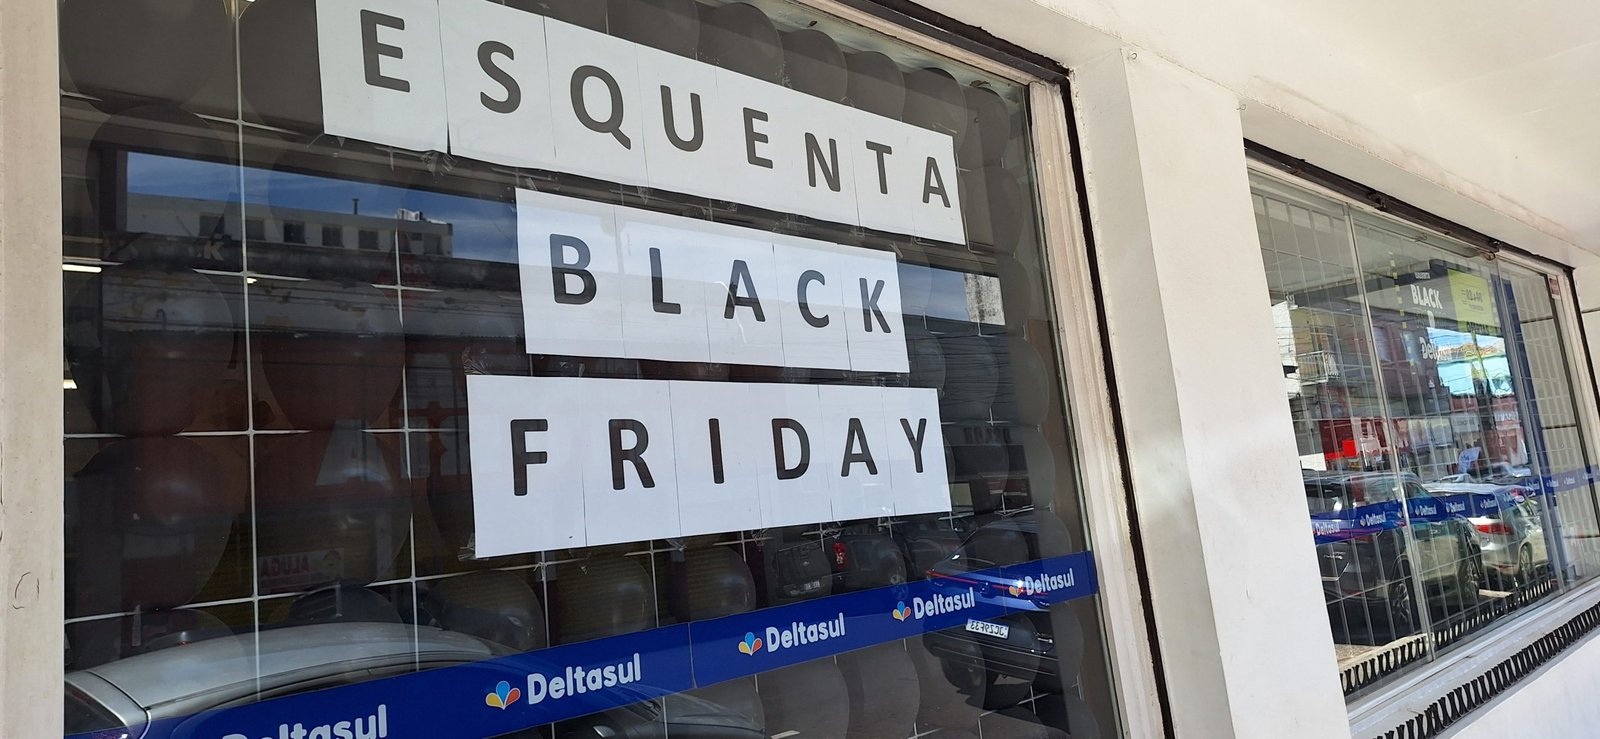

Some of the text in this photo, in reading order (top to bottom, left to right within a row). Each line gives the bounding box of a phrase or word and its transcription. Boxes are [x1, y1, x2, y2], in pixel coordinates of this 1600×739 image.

[360, 9, 952, 209] ESQUENTA
[549, 233, 893, 336] BLACK
[1410, 283, 1443, 310] BLACK
[509, 417, 928, 497] FRIDAY
[913, 587, 975, 620] Deltasul
[1022, 568, 1075, 596] Deltasul
[766, 612, 845, 652] Deltasul
[528, 653, 641, 705] Deltasul
